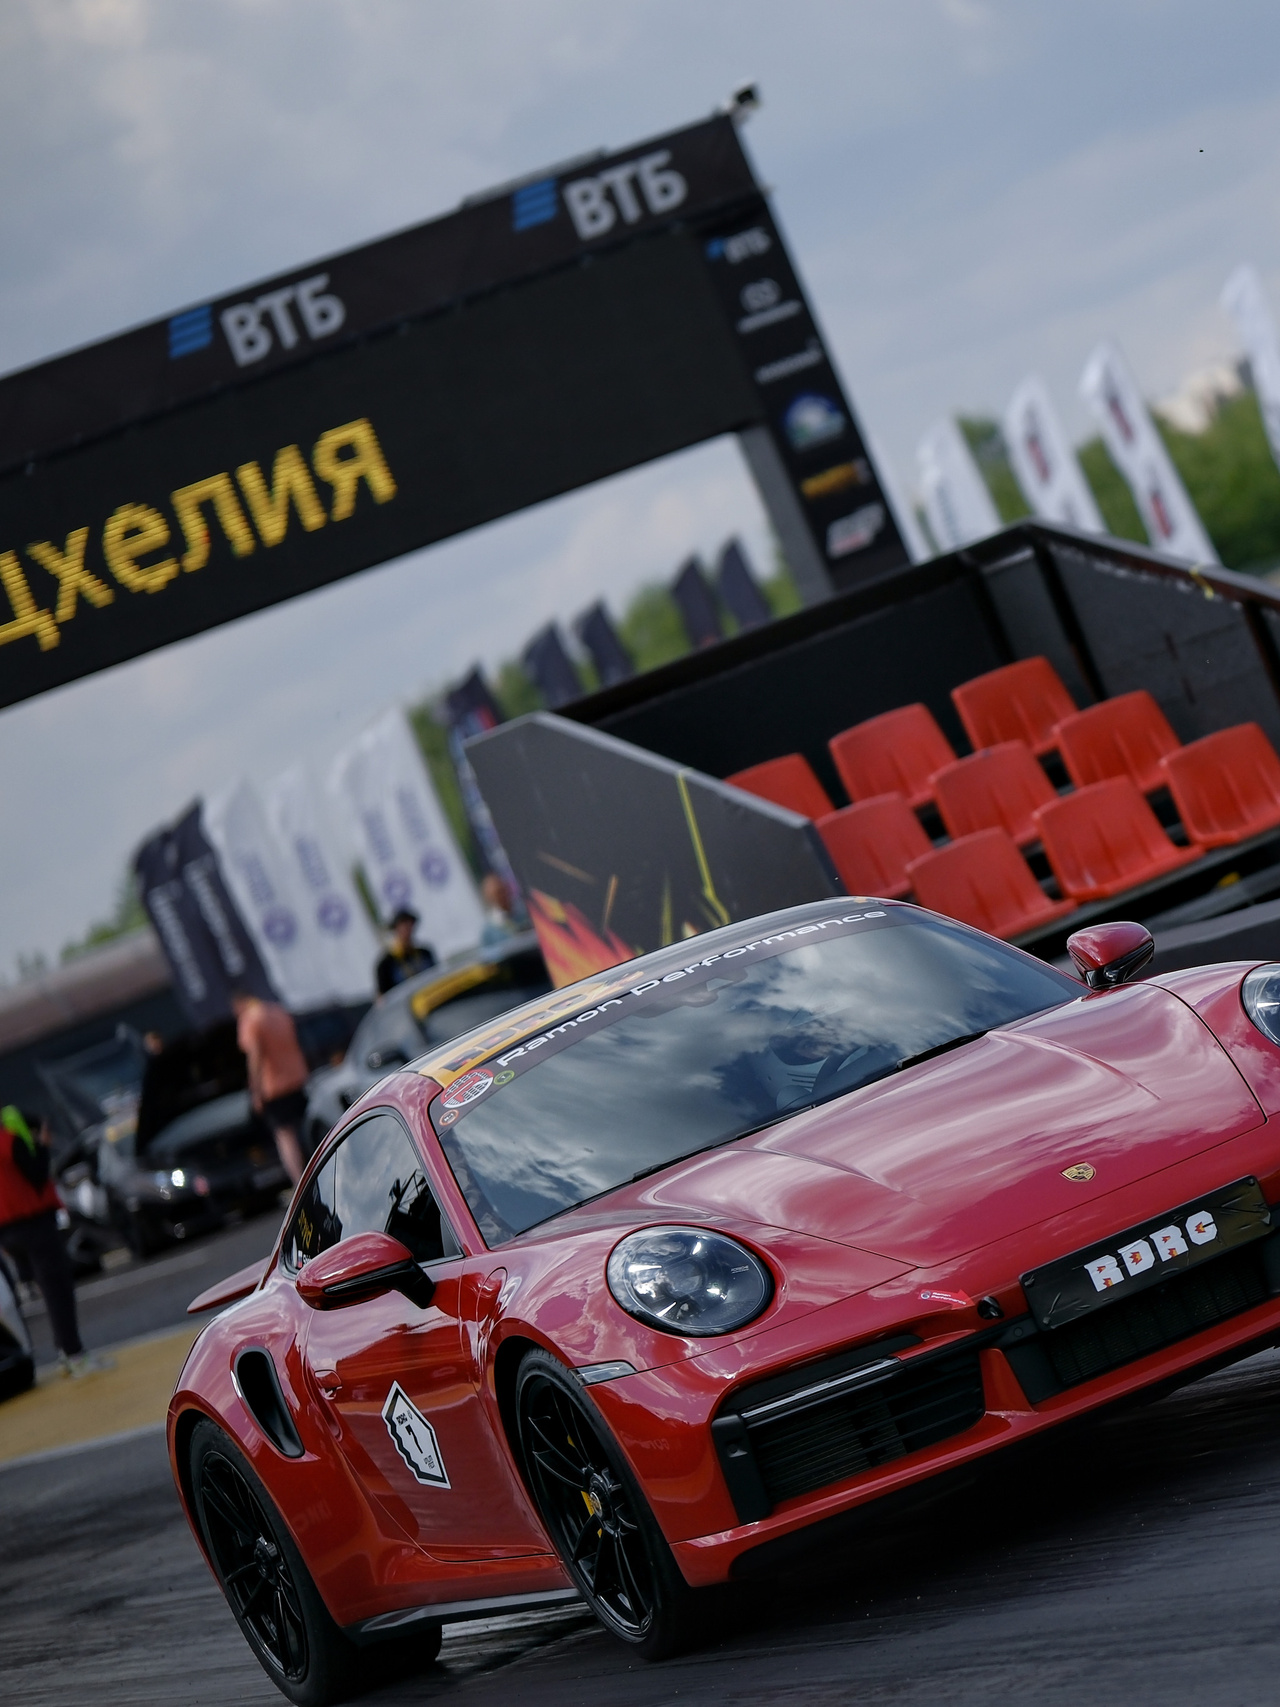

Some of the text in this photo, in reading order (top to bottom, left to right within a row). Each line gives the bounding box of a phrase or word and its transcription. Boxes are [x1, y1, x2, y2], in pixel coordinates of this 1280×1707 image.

[563, 149, 688, 241] ВТБ
[219, 273, 346, 367] ВТБ
[496, 910, 888, 1067] Ramon Performance
[1083, 1210, 1218, 1292] RDRC
[405, 1424, 423, 1453] 7
